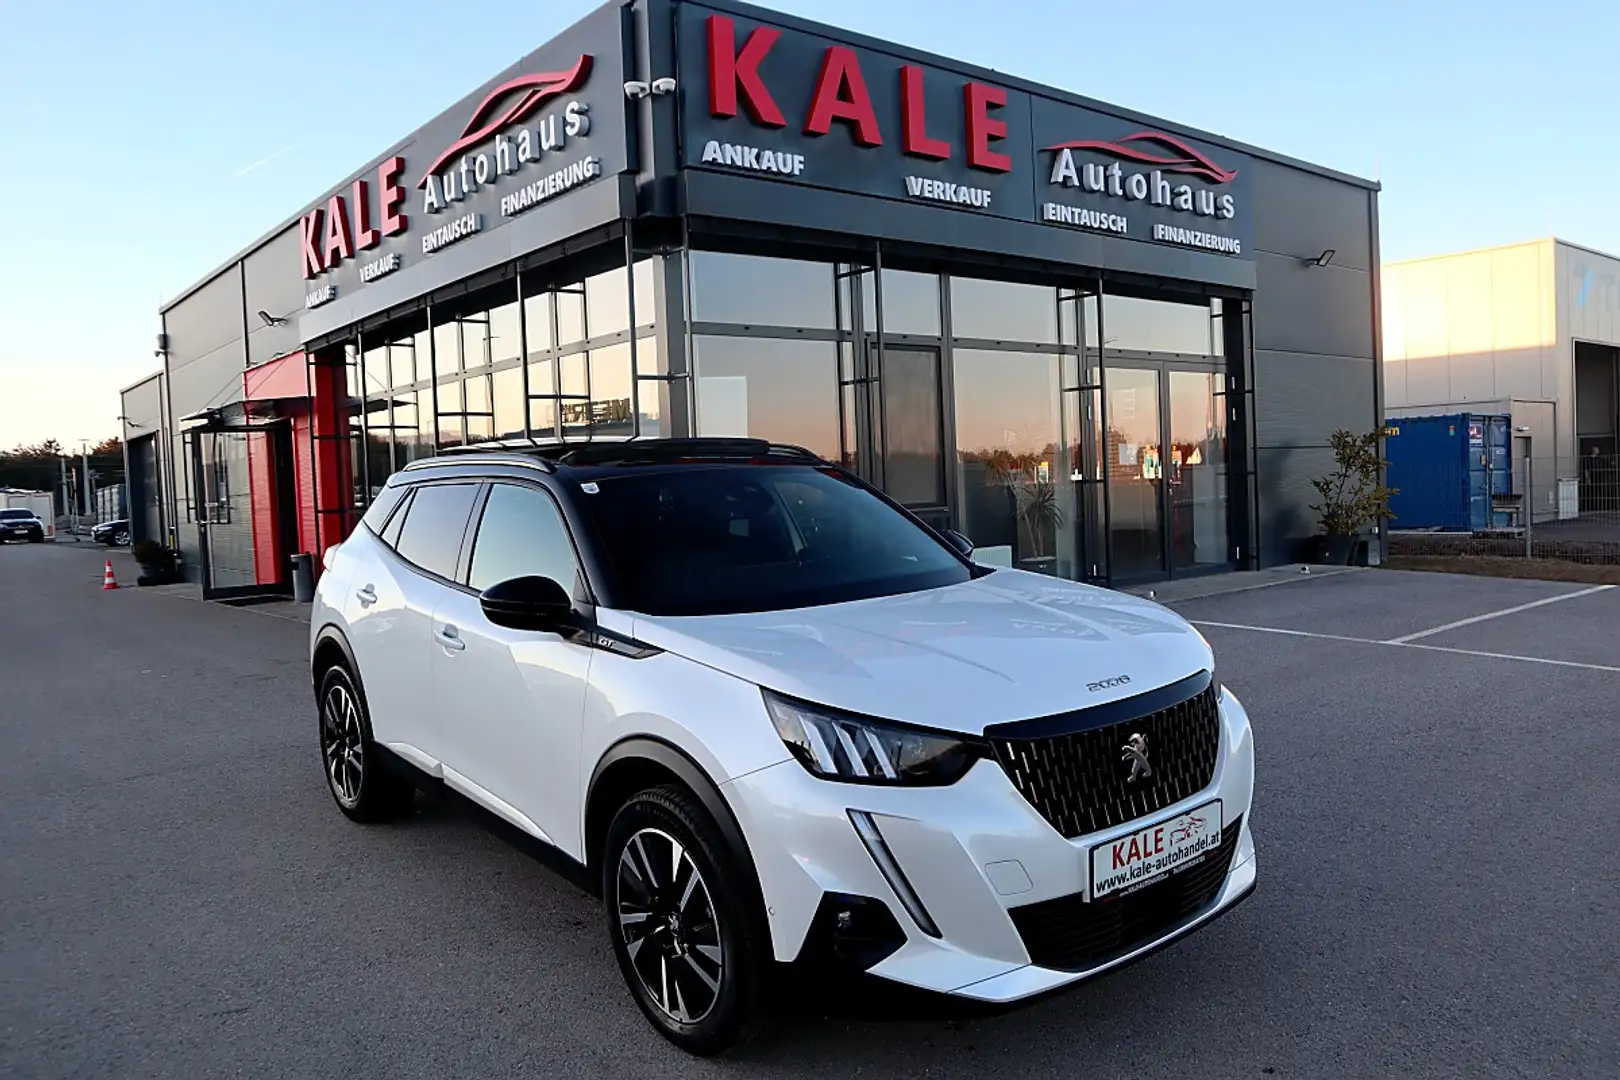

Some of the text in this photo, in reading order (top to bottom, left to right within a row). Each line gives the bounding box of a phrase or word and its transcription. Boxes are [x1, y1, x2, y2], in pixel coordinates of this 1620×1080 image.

[706, 14, 1011, 172] KALE
[424, 100, 591, 214] Autohaus
[702, 140, 804, 176] ANKAUF
[501, 156, 600, 216] FINANZIERUNG
[905, 175, 991, 208] VERKAUF
[1050, 148, 1235, 219] Autohaus
[299, 156, 408, 280] KALE
[422, 213, 482, 253] EINTAUSCH
[1043, 202, 1128, 233] EINTAUSCH
[1153, 224, 1241, 254] FINANZIERUNG
[359, 253, 400, 282] VERKAUF
[1086, 674, 1131, 692] 2008
[1096, 830, 1221, 893] www.kale-autohandel.at
[1111, 827, 1164, 870] KALE
